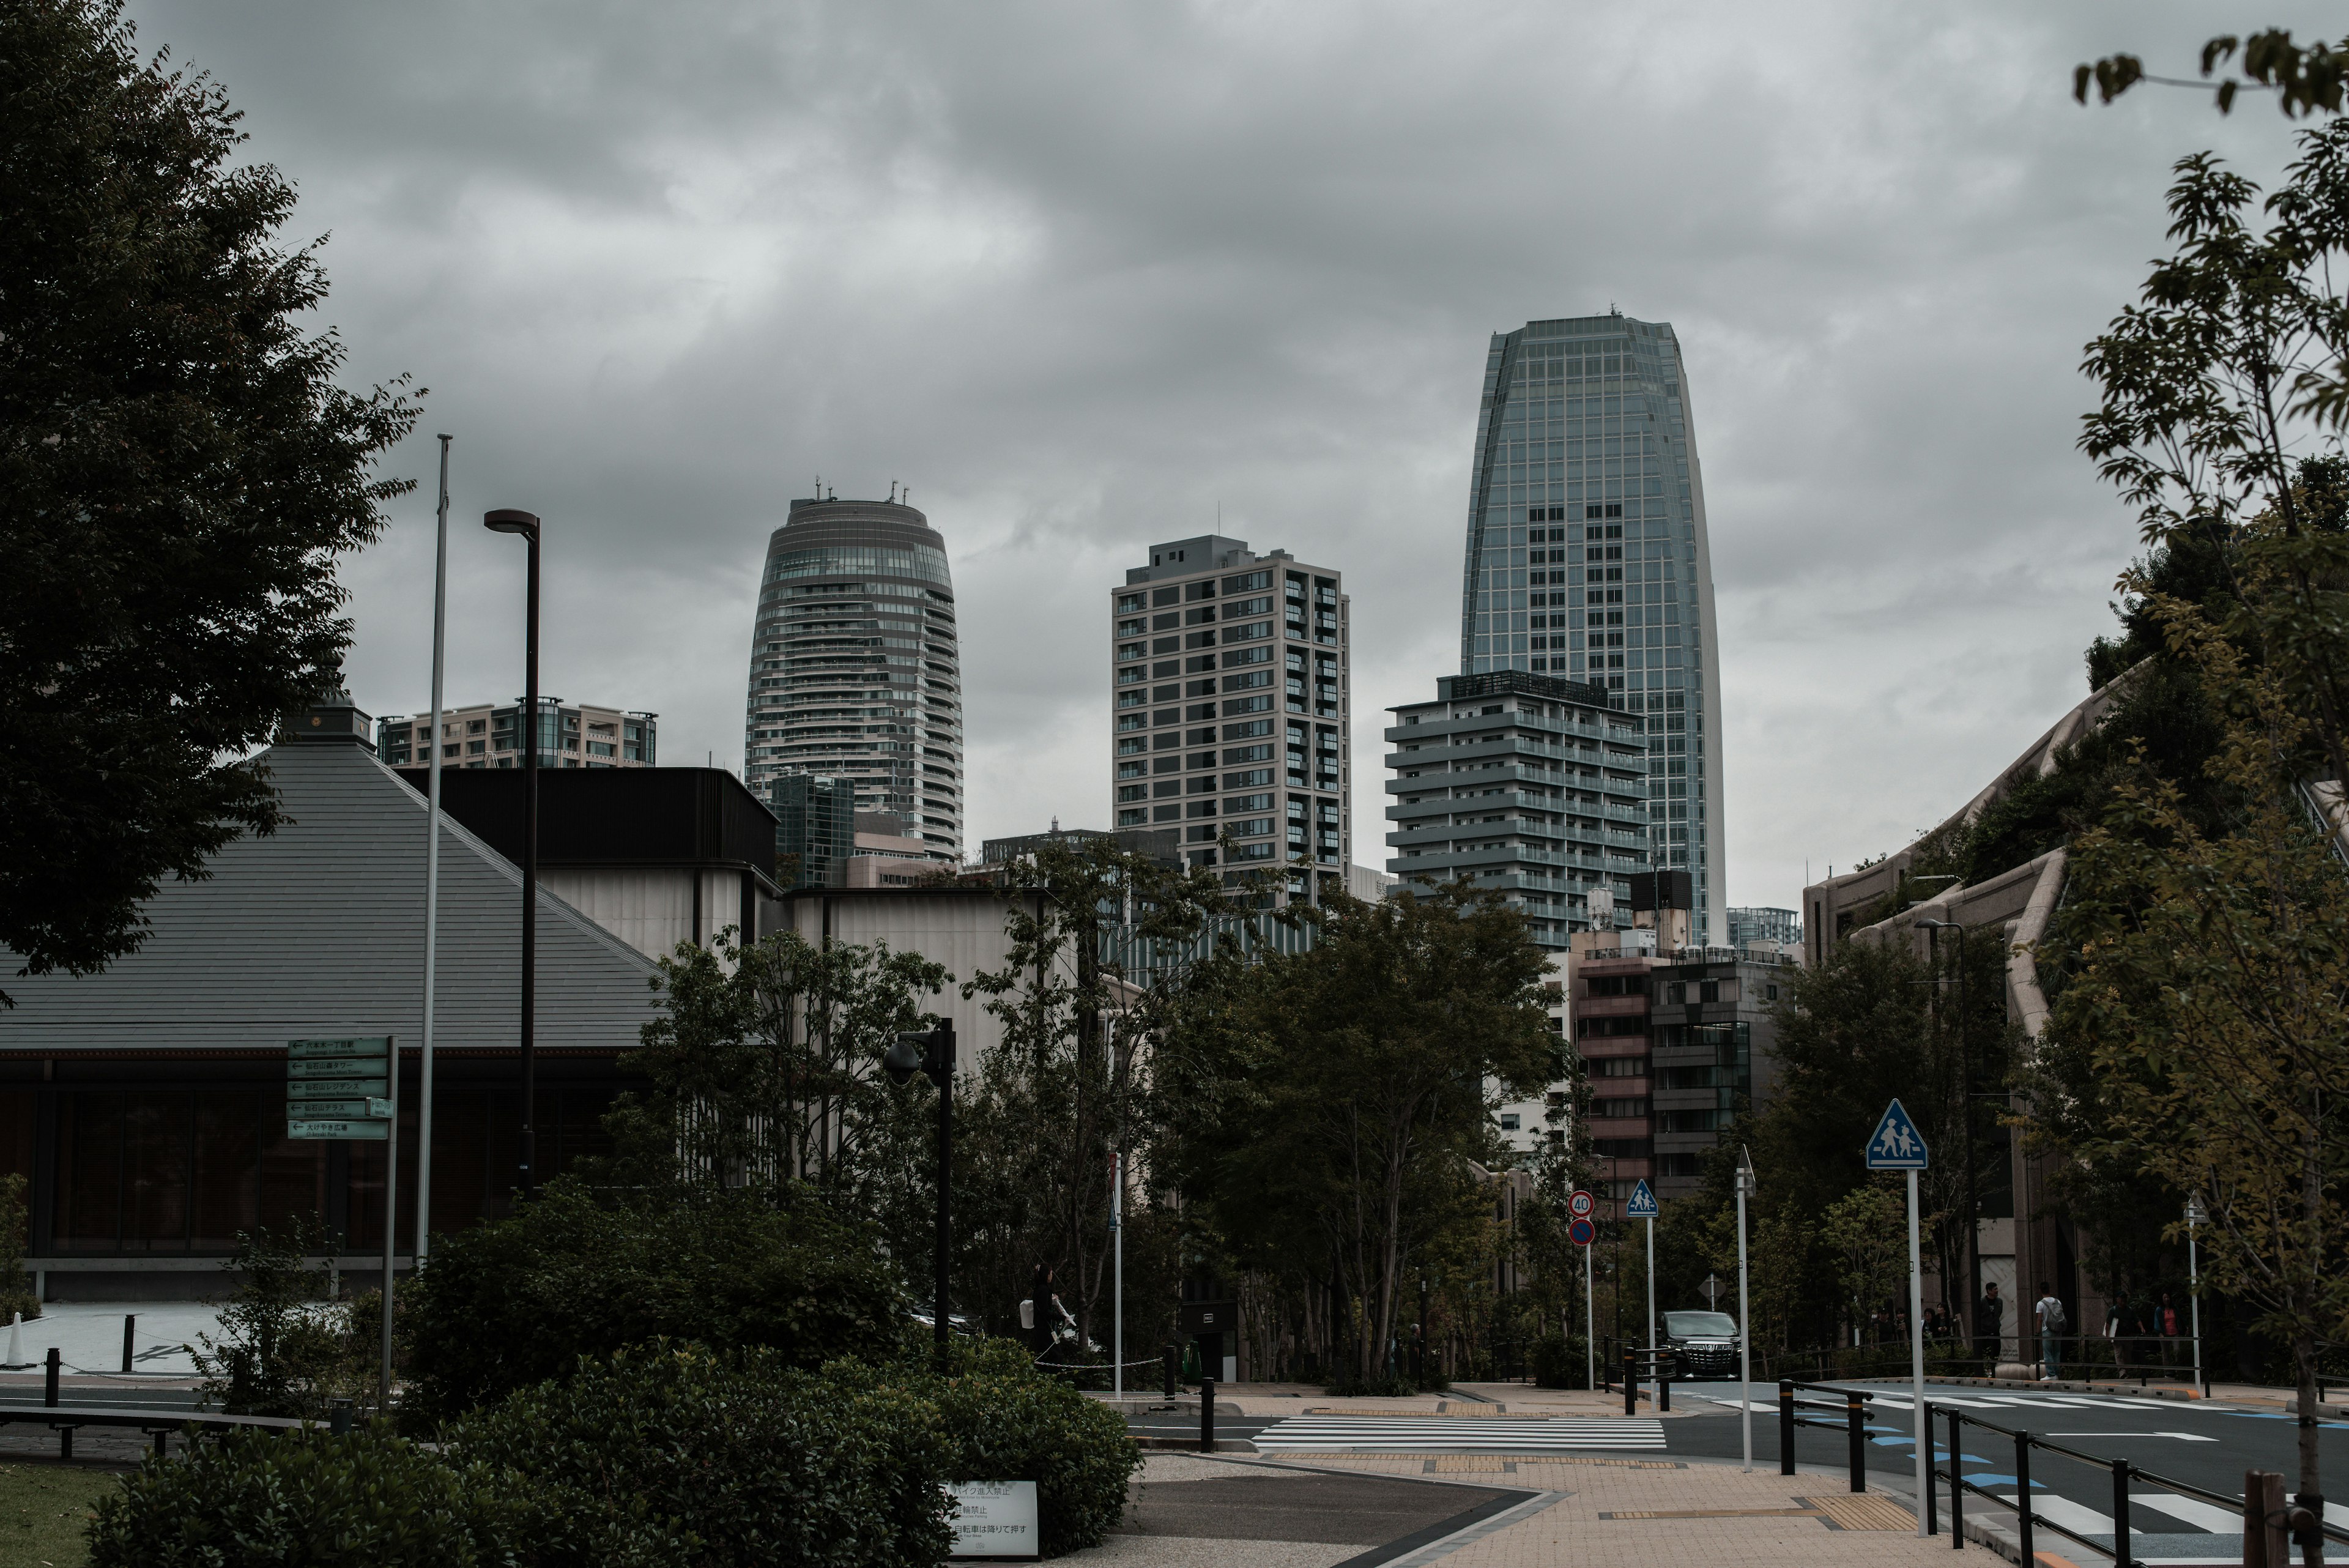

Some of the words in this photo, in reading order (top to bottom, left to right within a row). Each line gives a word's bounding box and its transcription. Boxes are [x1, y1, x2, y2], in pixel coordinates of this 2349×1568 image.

[1575, 1198, 1588, 1210] 40
[955, 1525, 1026, 1534] 自転車は降りて押す
